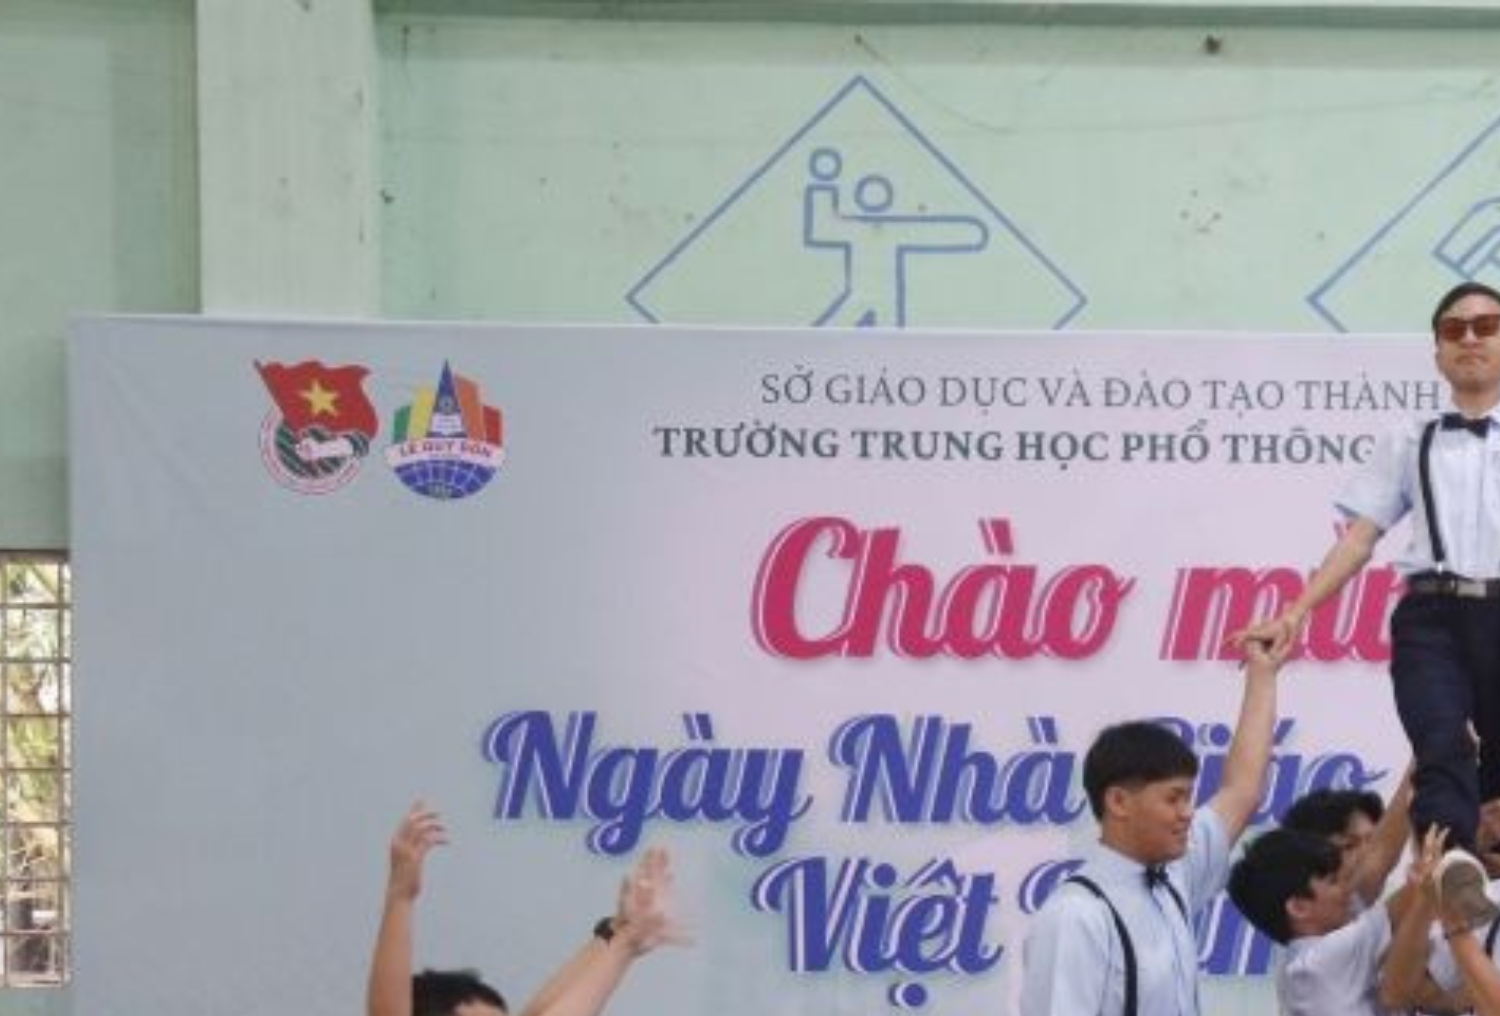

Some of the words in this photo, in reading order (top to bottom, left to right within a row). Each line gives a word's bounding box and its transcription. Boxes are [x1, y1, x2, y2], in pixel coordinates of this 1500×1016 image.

[652, 420, 840, 459] TRƯỜNG
[851, 429, 1005, 461] TRUNG
[1015, 431, 1110, 472] HỌC
[1120, 418, 1211, 463] PHỐ
[1222, 425, 1377, 464] THÔNG
[761, 364, 814, 405] SỞ
[825, 367, 926, 407] GIÁO
[939, 376, 1028, 416] DỤC
[1037, 367, 1091, 407] VÀ
[1103, 369, 1191, 409] ĐÀO
[1202, 379, 1285, 419] TẠO
[1295, 372, 1441, 411] THÀNH
[751, 516, 1137, 661] Chào
[482, 709, 812, 856] Ngày
[829, 713, 1088, 825] Nhà
[1150, 716, 1388, 826] iáo
[753, 855, 1004, 1009] Việt
